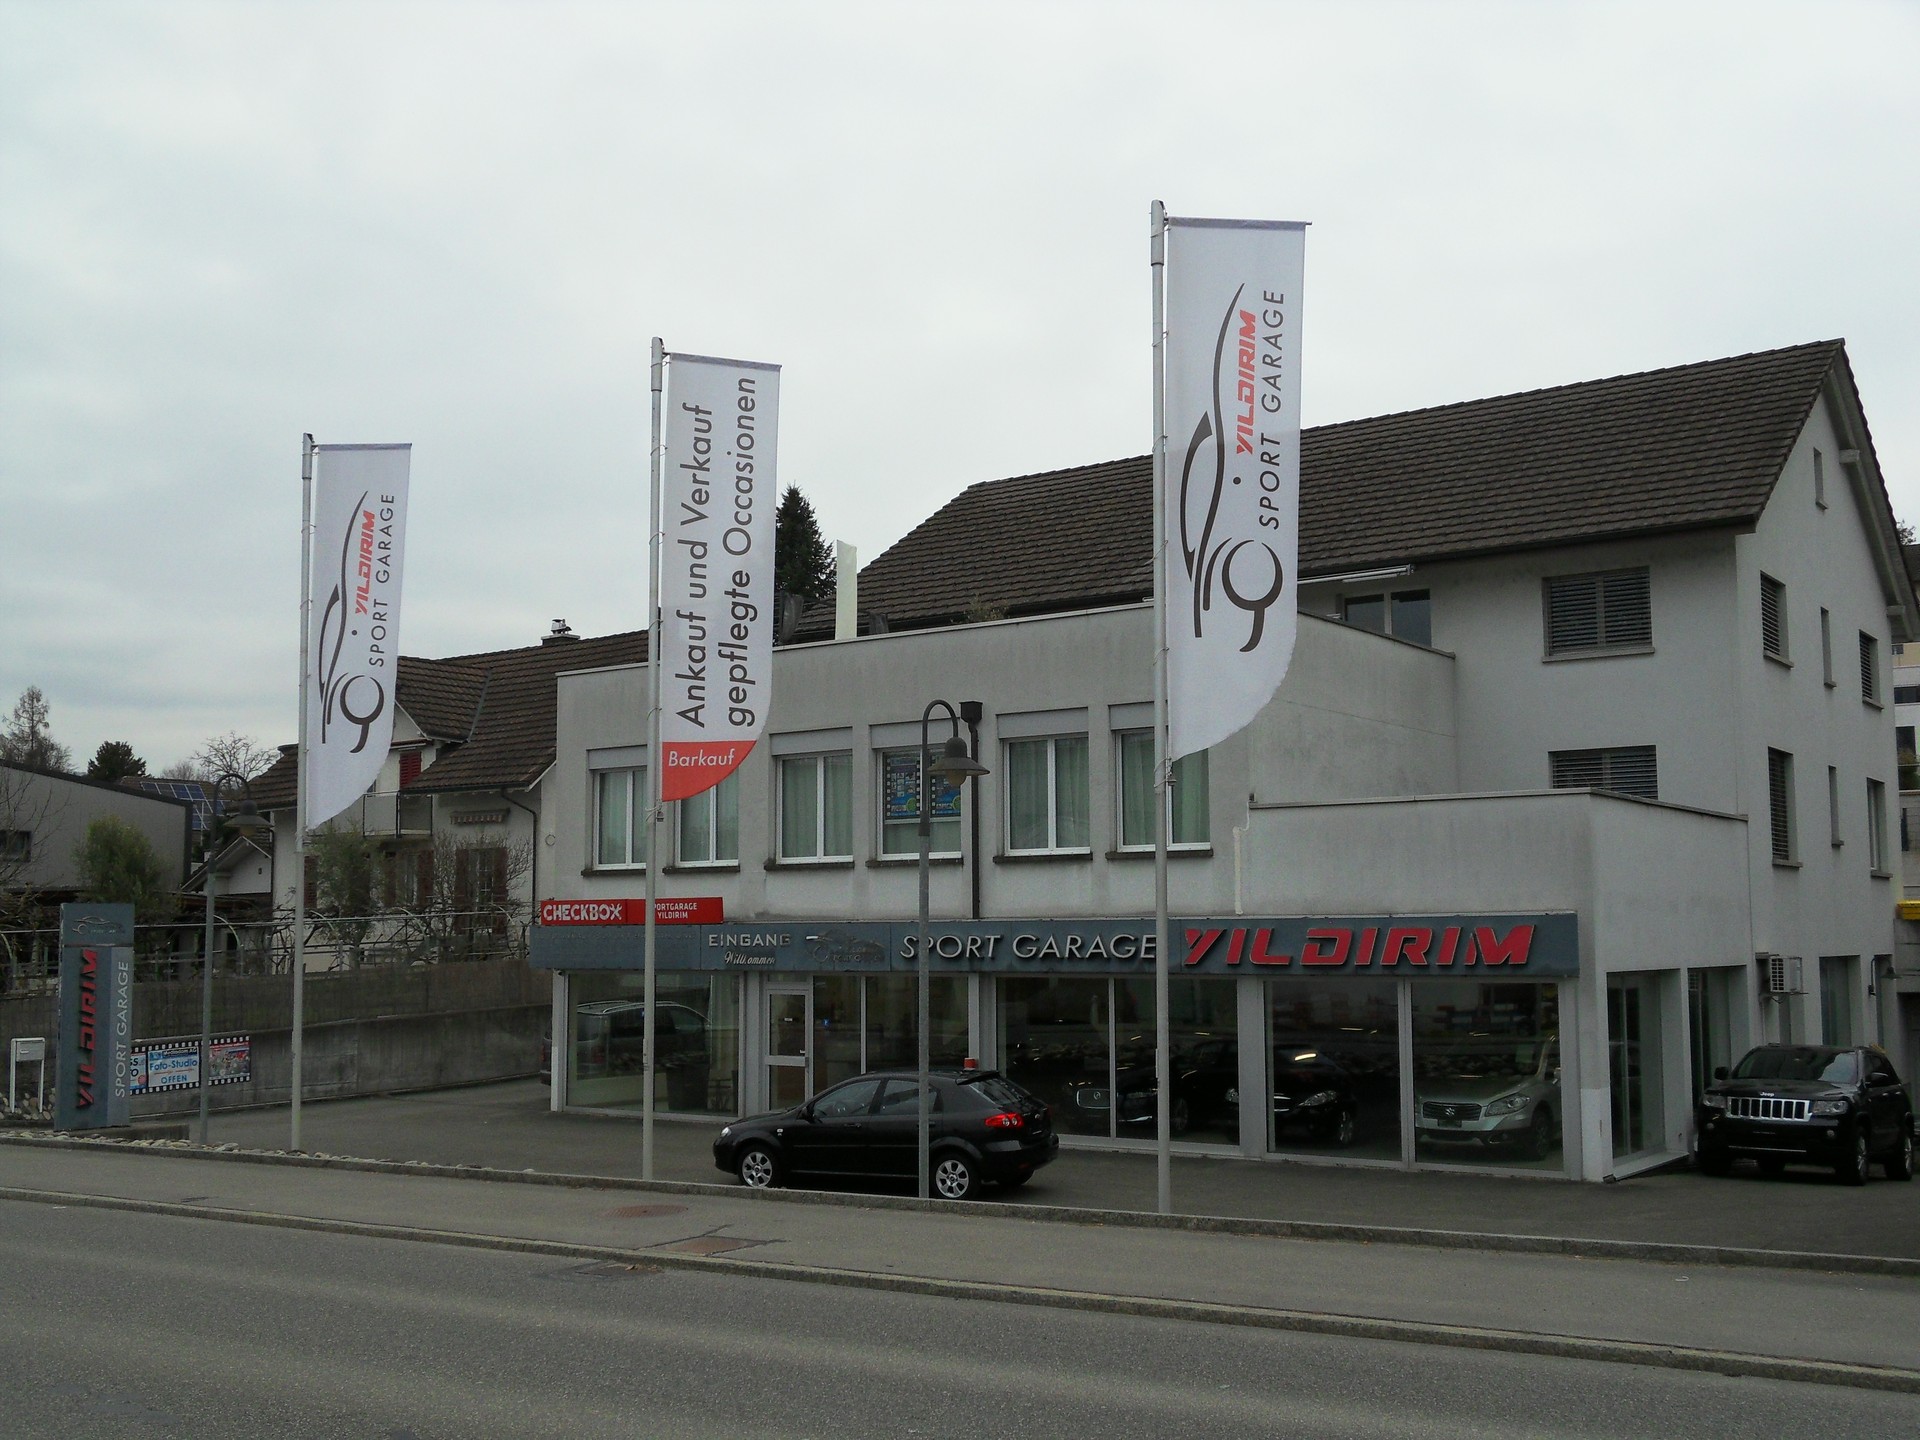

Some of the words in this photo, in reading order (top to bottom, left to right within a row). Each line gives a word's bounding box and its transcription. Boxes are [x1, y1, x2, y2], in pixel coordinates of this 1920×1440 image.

[1236, 310, 1257, 454] YILDIRIM
[1260, 291, 1284, 413] GARAGE
[680, 402, 712, 526] Verkauf
[722, 377, 757, 556] Occasionen
[1258, 433, 1281, 530] SPORT
[355, 510, 375, 616] YILDIRIM
[375, 494, 395, 584] GARAGE
[678, 540, 708, 598] und
[369, 598, 389, 667] SPORT
[717, 570, 758, 727] gepflegte
[675, 609, 707, 728] Ankauf
[668, 748, 735, 768] Barkauf
[543, 903, 622, 921] CHECKBOX
[654, 902, 698, 911] ORTGARAGE
[657, 911, 688, 919] YILDIRIM
[708, 932, 791, 947] EINGANG
[724, 950, 776, 964] Willommen
[1012, 934, 1156, 959] GARAGE
[1184, 925, 1536, 966] YILDIRIM
[78, 950, 98, 1106] YILDIRIM
[116, 961, 129, 1036] GARAGE
[115, 1041, 128, 1098] SPORT
[149, 1059, 198, 1071] Foto-Studio
[161, 1074, 187, 1084] OFFEN
